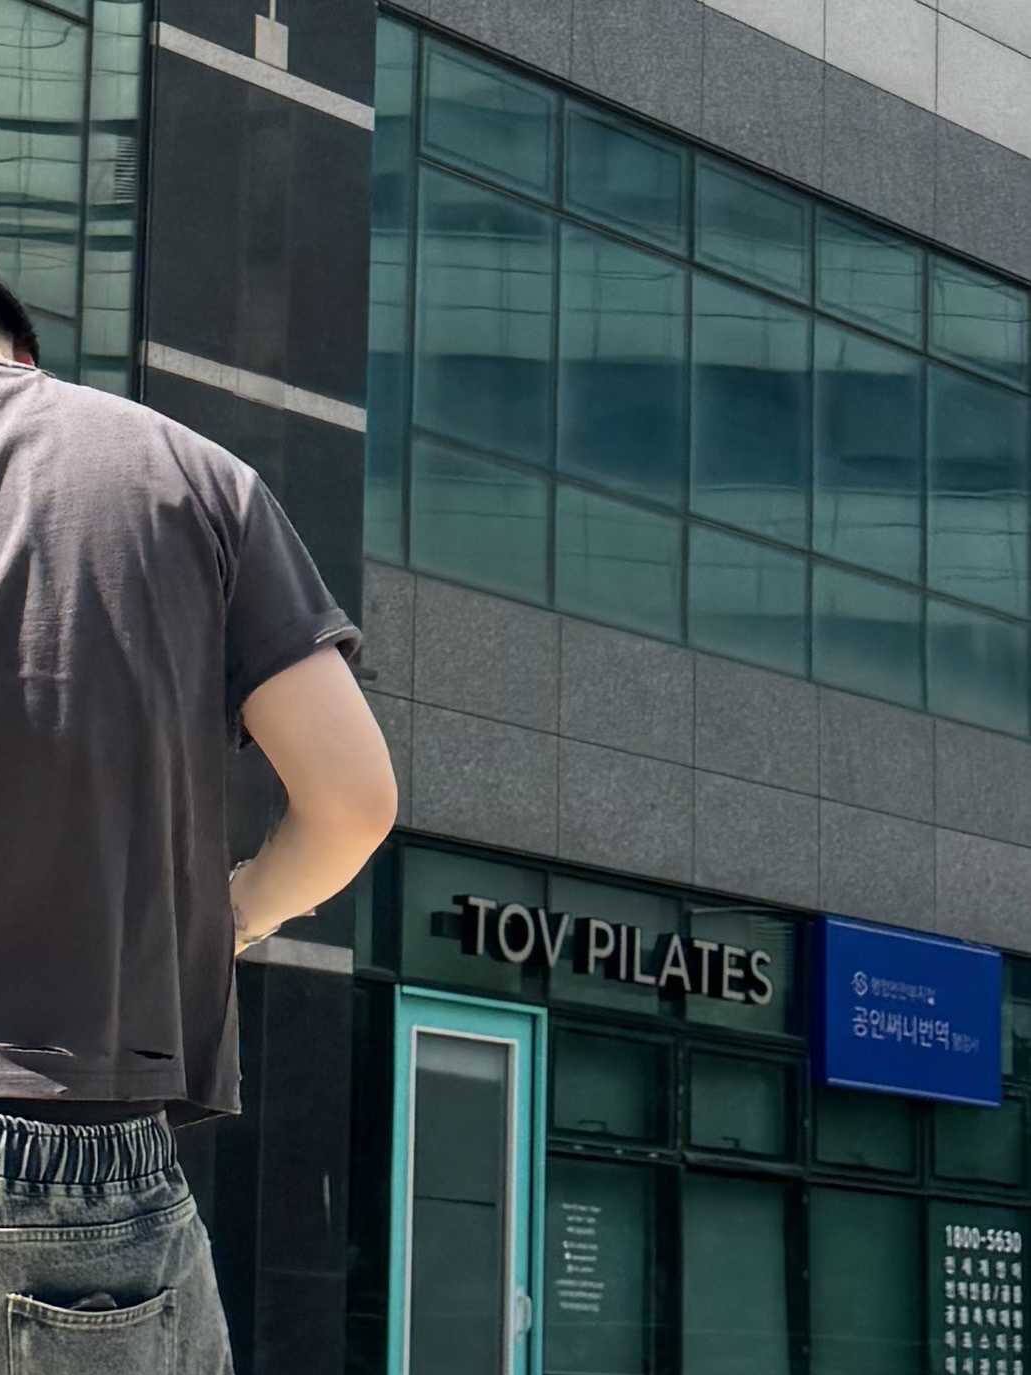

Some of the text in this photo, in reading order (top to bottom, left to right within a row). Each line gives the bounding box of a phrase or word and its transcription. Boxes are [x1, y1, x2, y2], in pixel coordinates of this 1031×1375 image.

[467, 895, 774, 1005] TOV PILATES
[945, 1224, 1023, 1254] 1800-5630
